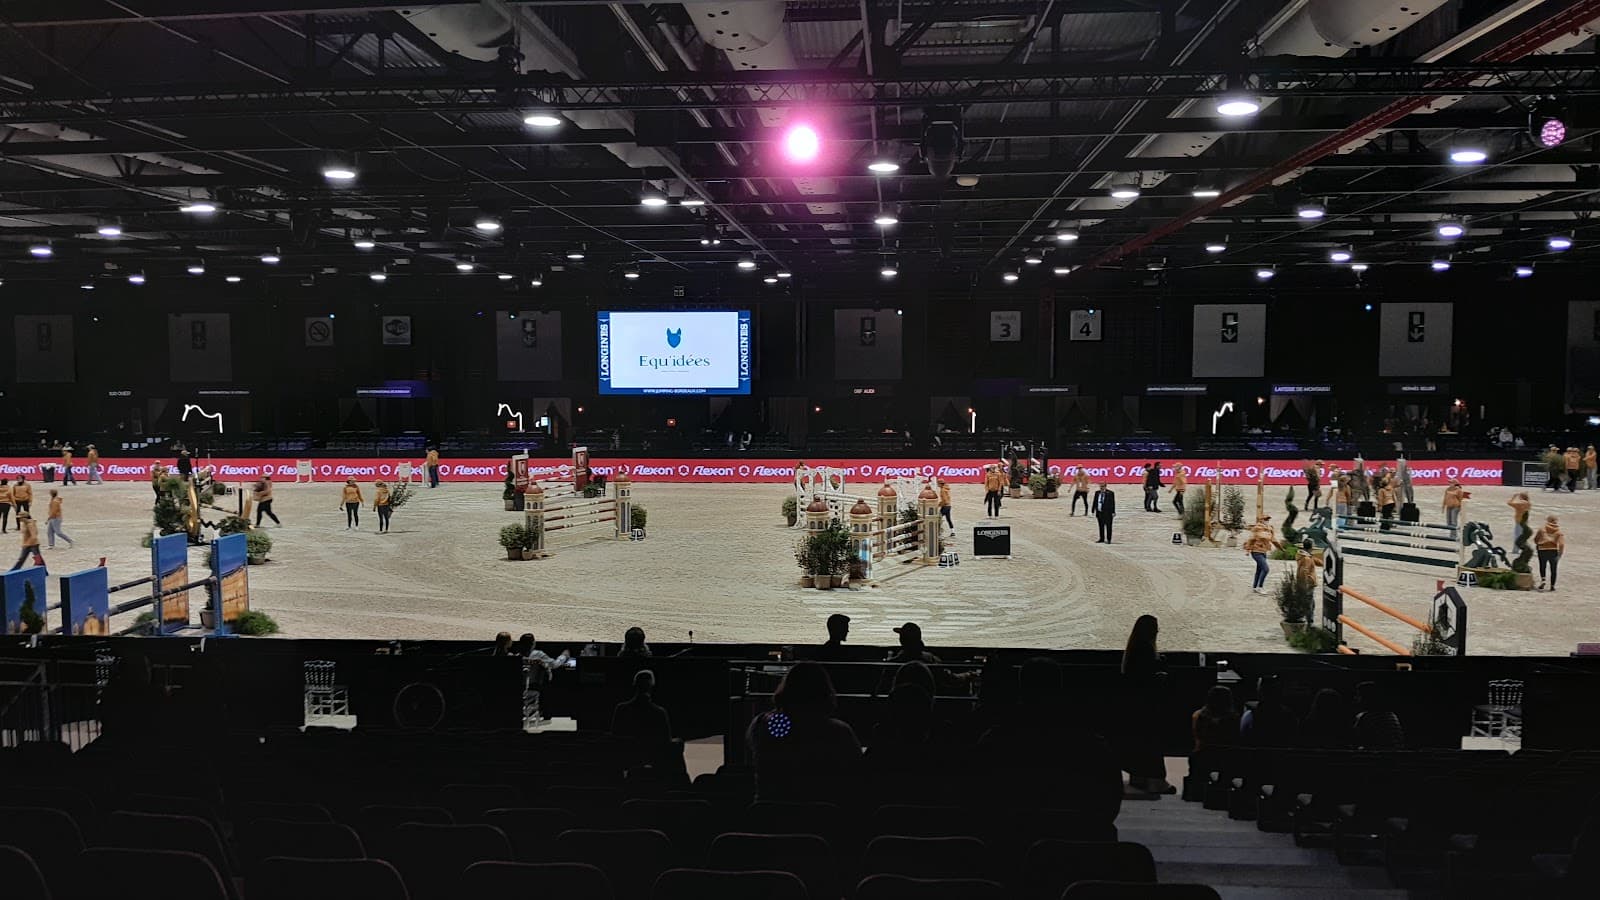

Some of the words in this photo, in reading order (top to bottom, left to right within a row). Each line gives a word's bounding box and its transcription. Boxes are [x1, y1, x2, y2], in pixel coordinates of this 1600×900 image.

[1000, 323, 1011, 337] 3
[1080, 322, 1092, 336] 4
[600, 323, 609, 377] LONGINES
[740, 323, 749, 376] LONGINES
[639, 354, 711, 369] Equ'idées
